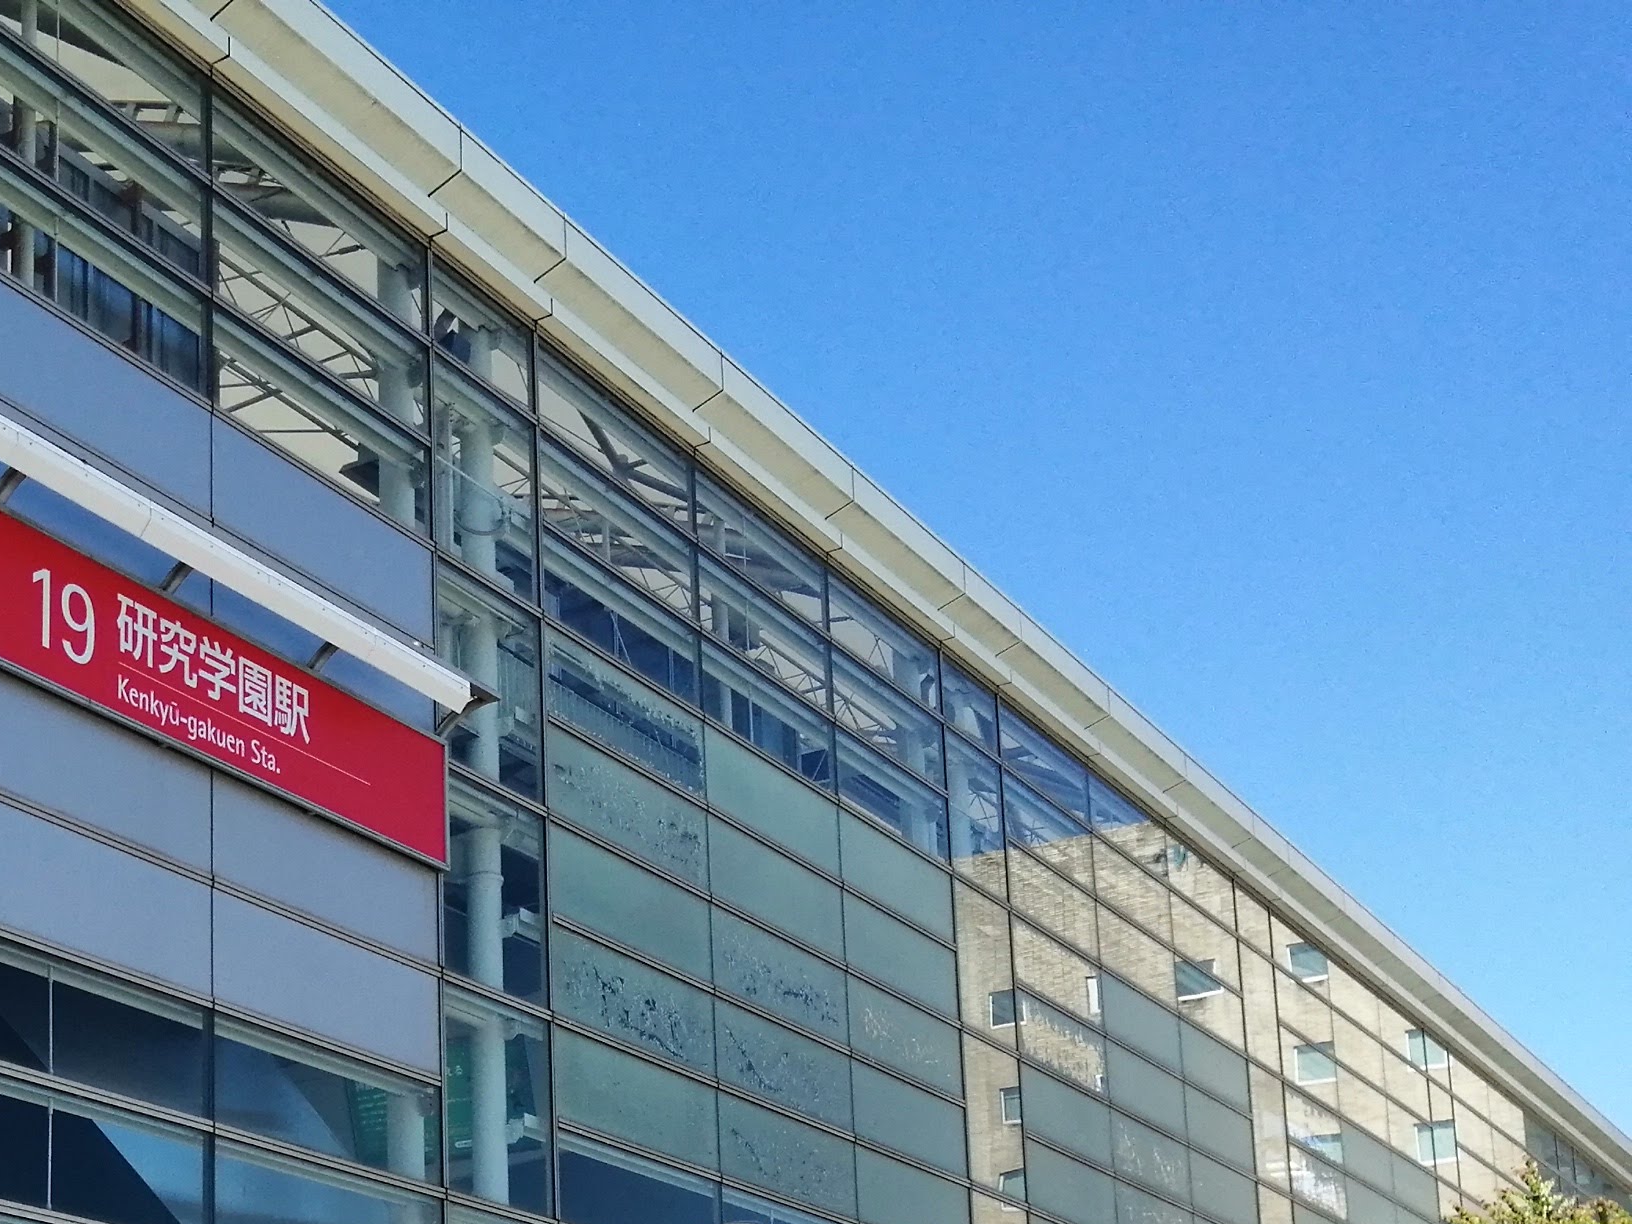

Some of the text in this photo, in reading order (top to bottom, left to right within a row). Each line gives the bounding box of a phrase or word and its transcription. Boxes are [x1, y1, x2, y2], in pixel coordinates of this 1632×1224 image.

[32, 568, 311, 745] 19 研究学園駅
[117, 674, 282, 775] Kenkyū-gakuen Sta.
